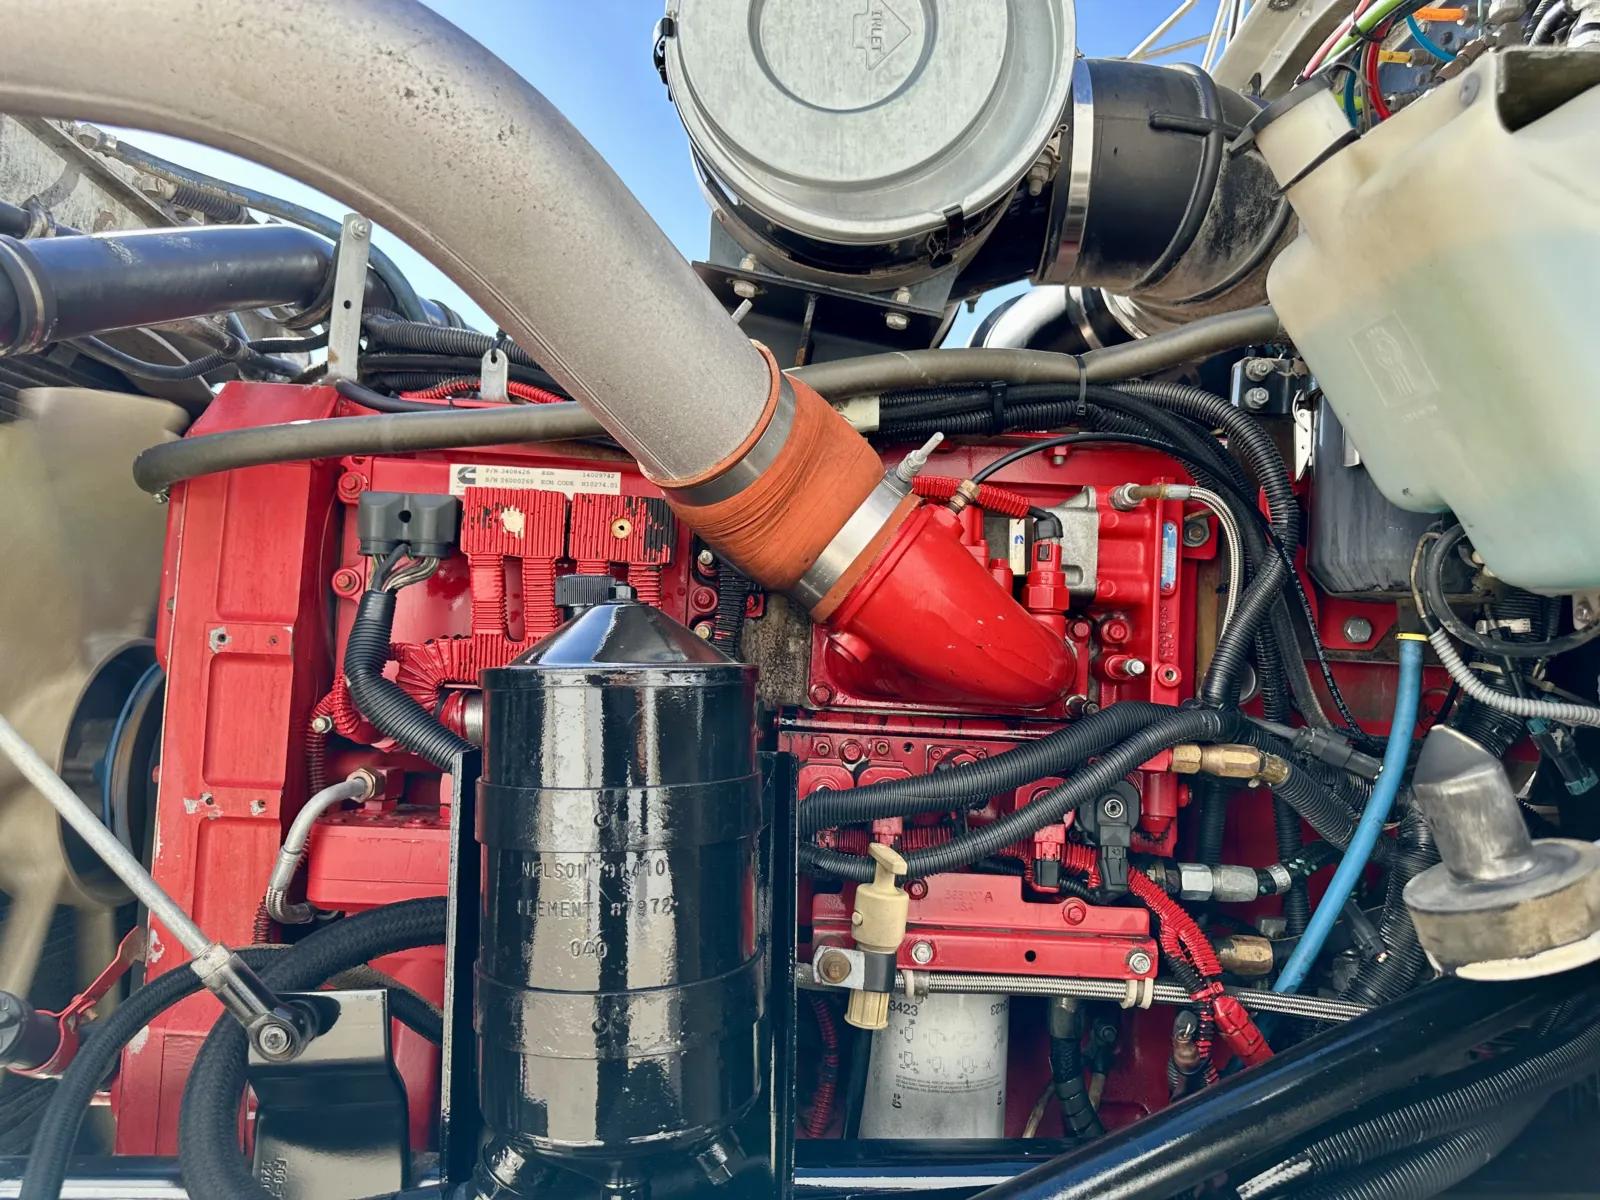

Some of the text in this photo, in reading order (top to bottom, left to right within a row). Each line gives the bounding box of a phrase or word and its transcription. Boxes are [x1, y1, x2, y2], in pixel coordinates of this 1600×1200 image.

[870, 10, 883, 53] INLET
[522, 859, 666, 878] NELSON 91410
[889, 999, 918, 1017] 3423
